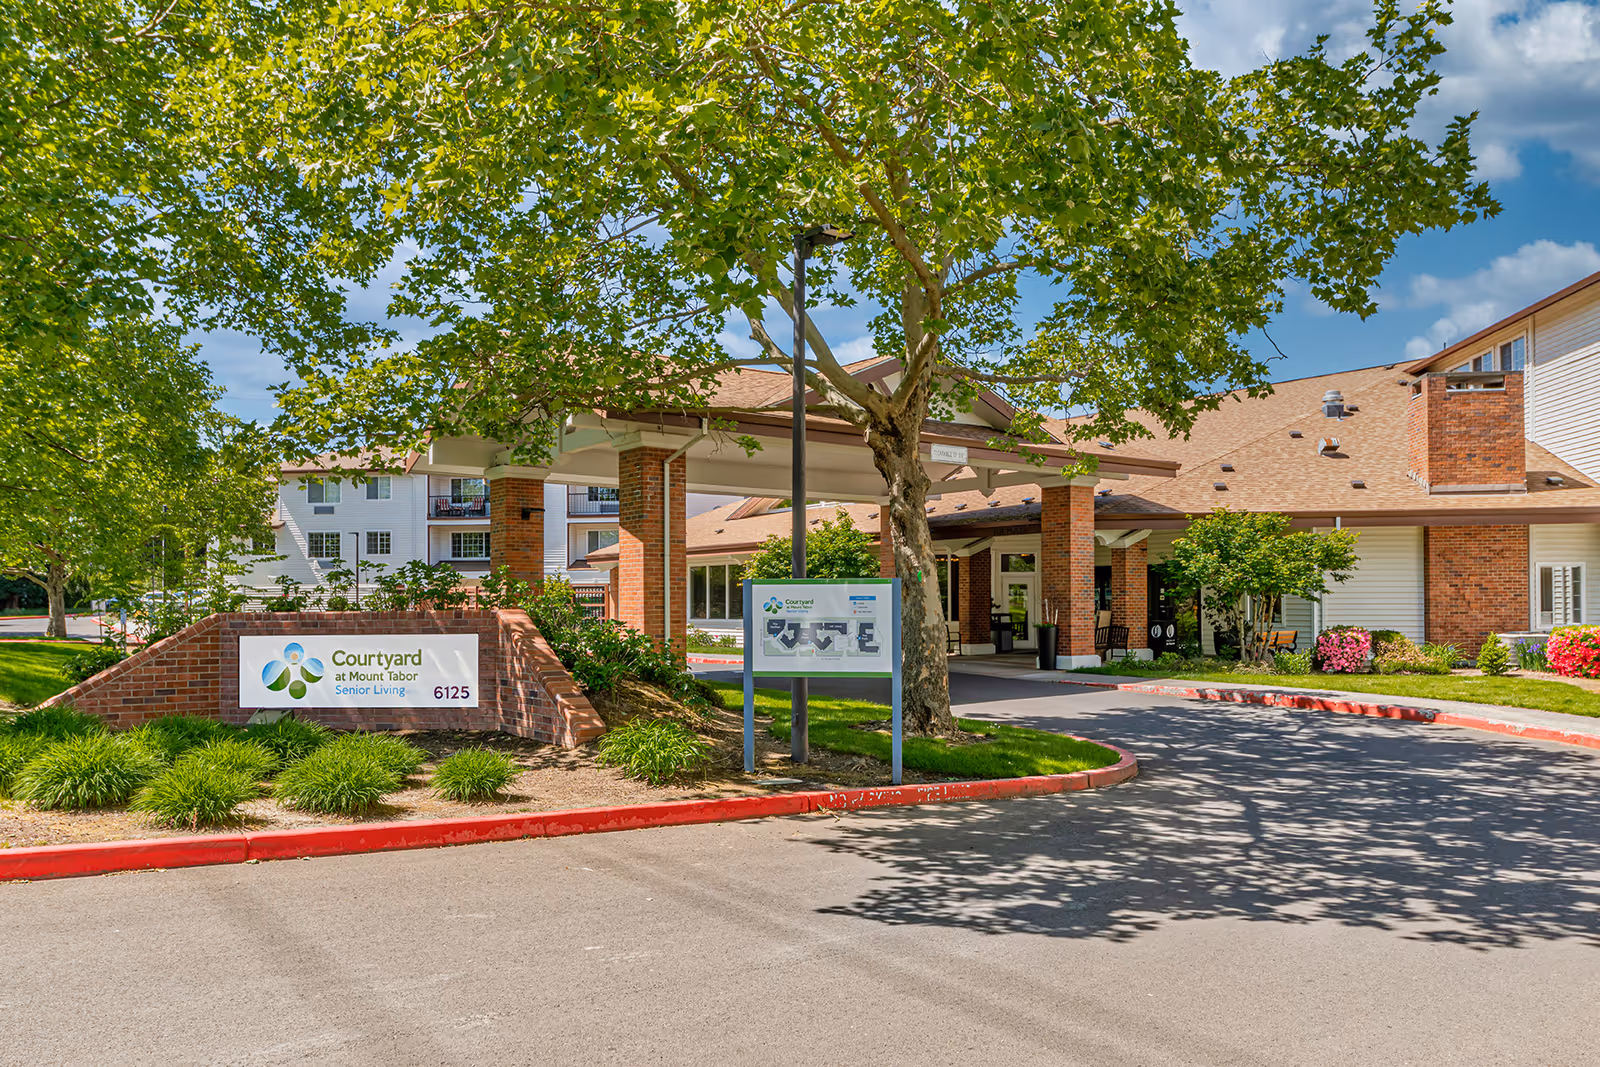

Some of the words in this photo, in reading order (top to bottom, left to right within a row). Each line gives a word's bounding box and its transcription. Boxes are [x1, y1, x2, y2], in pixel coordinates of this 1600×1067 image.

[331, 649, 422, 670] Courtyard
[335, 672, 346, 681] at
[349, 671, 384, 681] Mount
[387, 671, 418, 681] Tabor
[335, 684, 371, 695] Senior
[373, 684, 406, 697] Living
[433, 686, 470, 699] 6125
